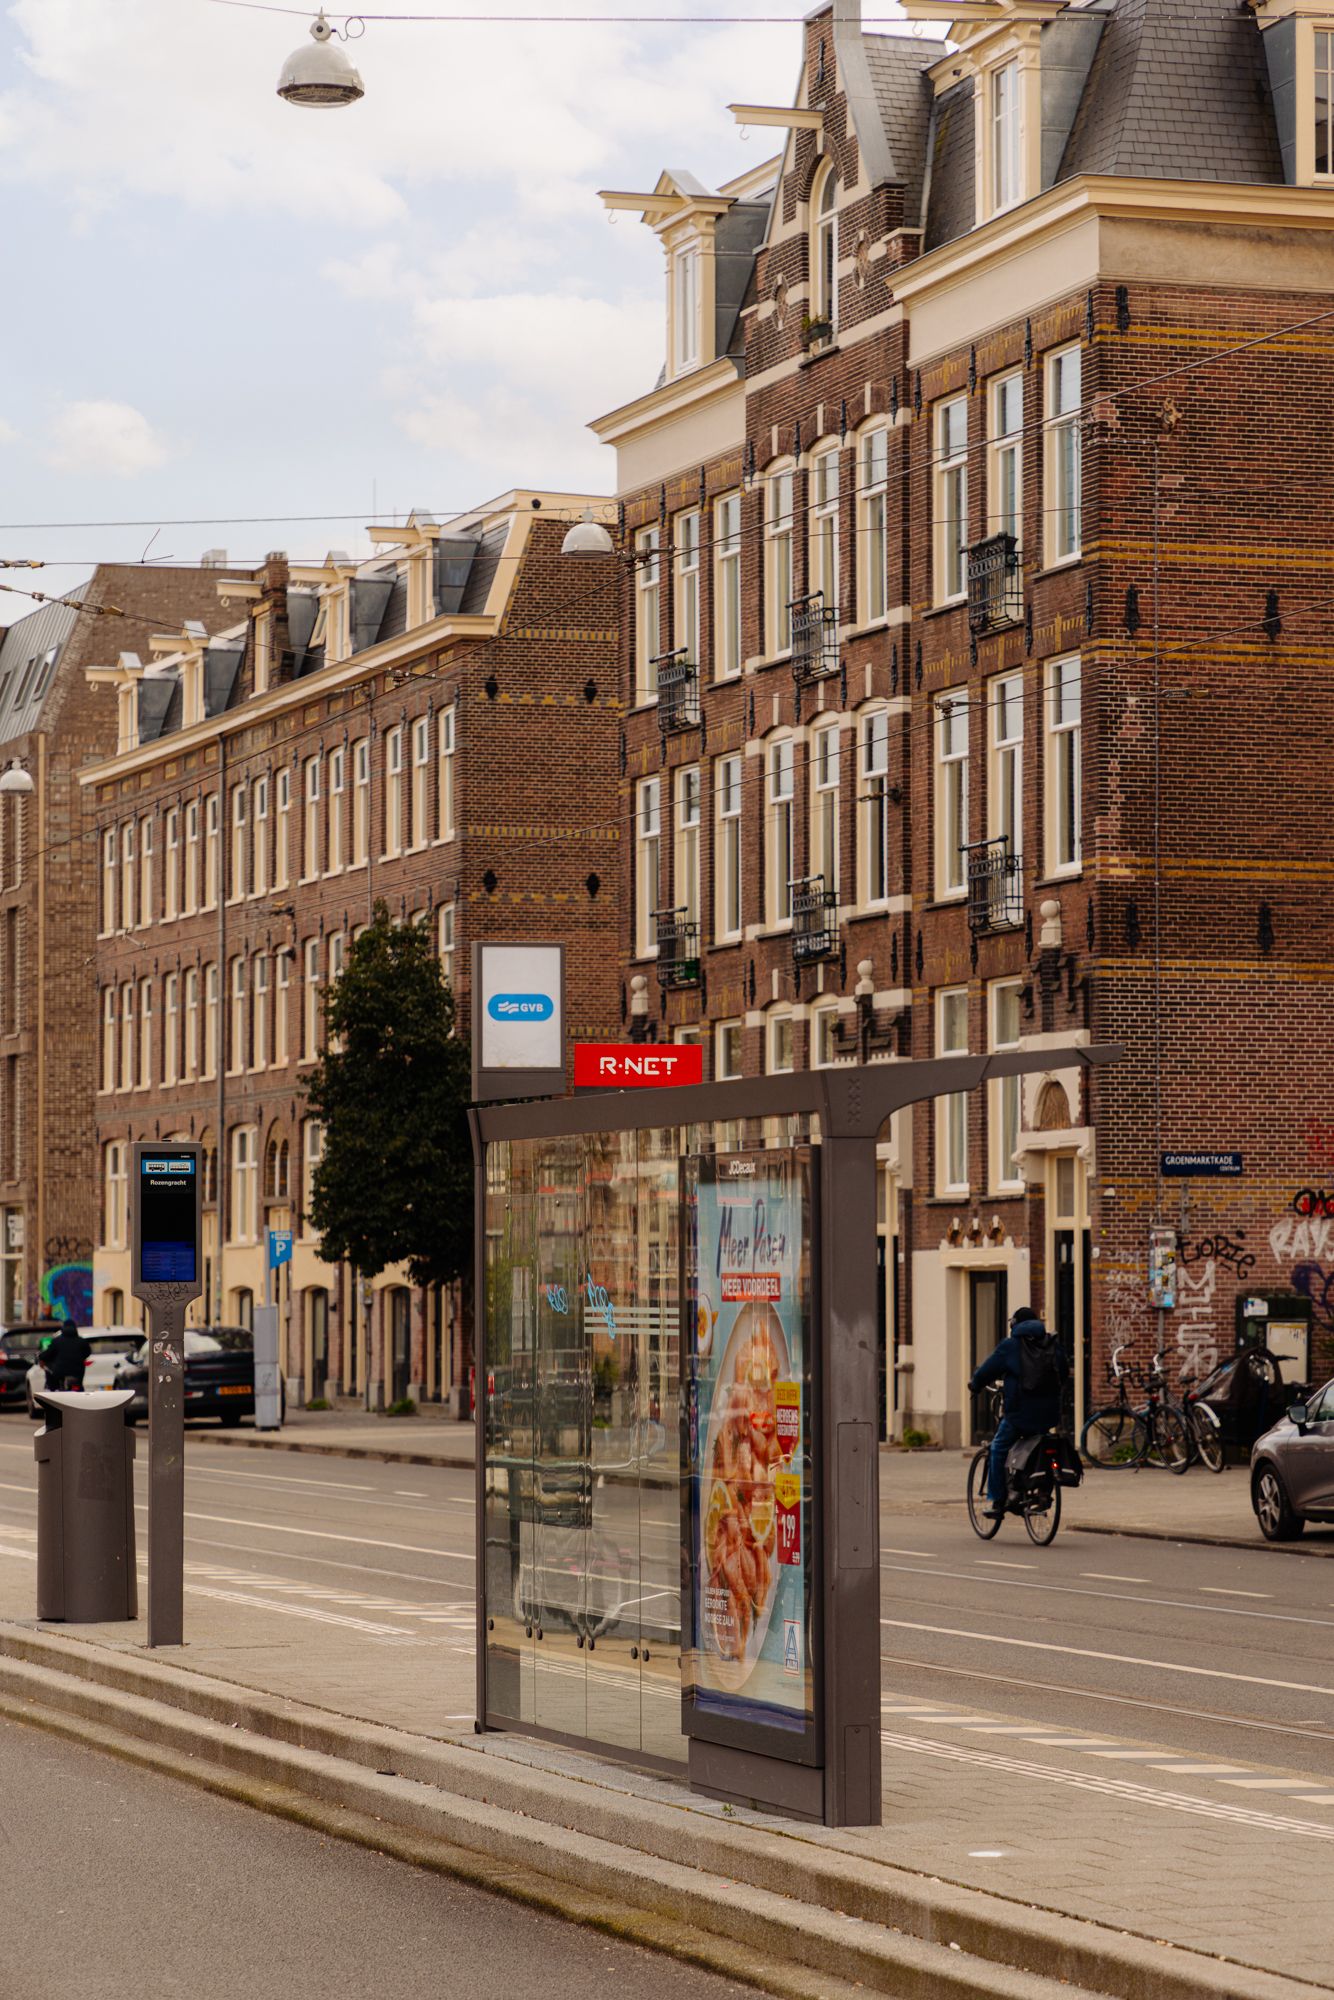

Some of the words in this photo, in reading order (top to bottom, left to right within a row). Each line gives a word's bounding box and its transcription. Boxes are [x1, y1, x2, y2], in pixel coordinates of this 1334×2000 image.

[520, 1003, 544, 1013] GVB
[728, 1160, 756, 1175] JCDecaux
[1165, 1155, 1233, 1166] GROENMARKTKADE
[150, 1178, 187, 1187] Rozengracht
[716, 1202, 749, 1278] Meer
[752, 1198, 786, 1273] Pasen
[275, 1240, 287, 1257] P
[721, 1277, 742, 1297] MEER
[743, 1278, 780, 1297] VOORDEEL
[776, 1408, 798, 1424] NERGENS
[781, 1513, 796, 1548] 1.99
[704, 1597, 728, 1611] GEROOKTE
[704, 1612, 722, 1625] NOORSE
[722, 1615, 735, 1627] ZALM
